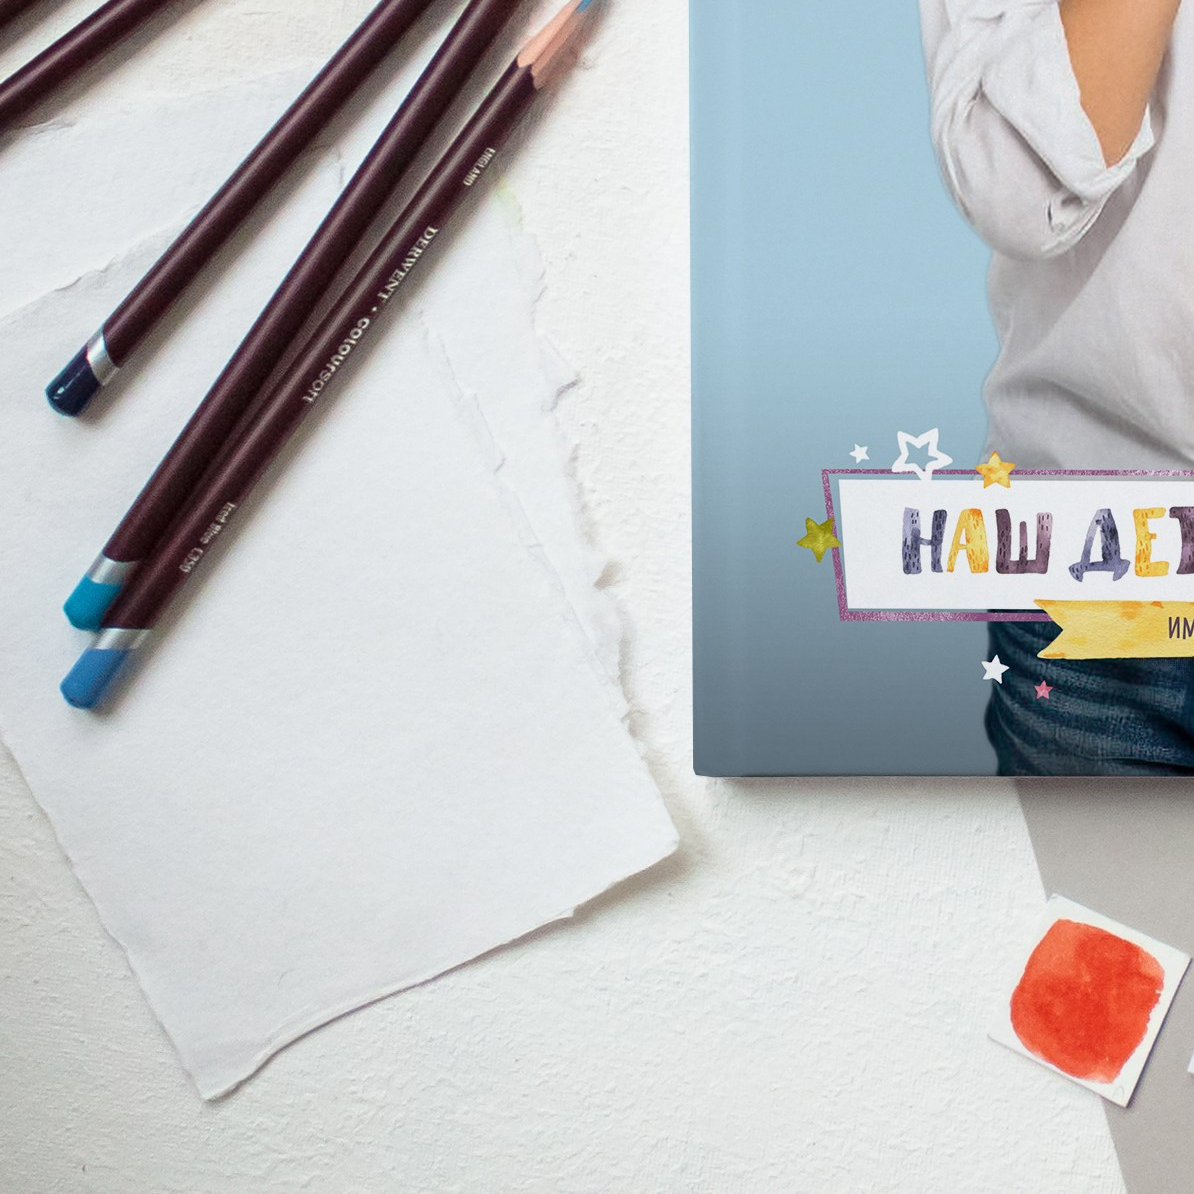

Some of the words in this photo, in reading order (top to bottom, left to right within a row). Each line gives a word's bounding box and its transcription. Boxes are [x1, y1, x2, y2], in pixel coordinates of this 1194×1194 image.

[377, 225, 439, 301] DERWENT
[302, 317, 370, 404] coloursoft
[901, 506, 1053, 575] НАШ
